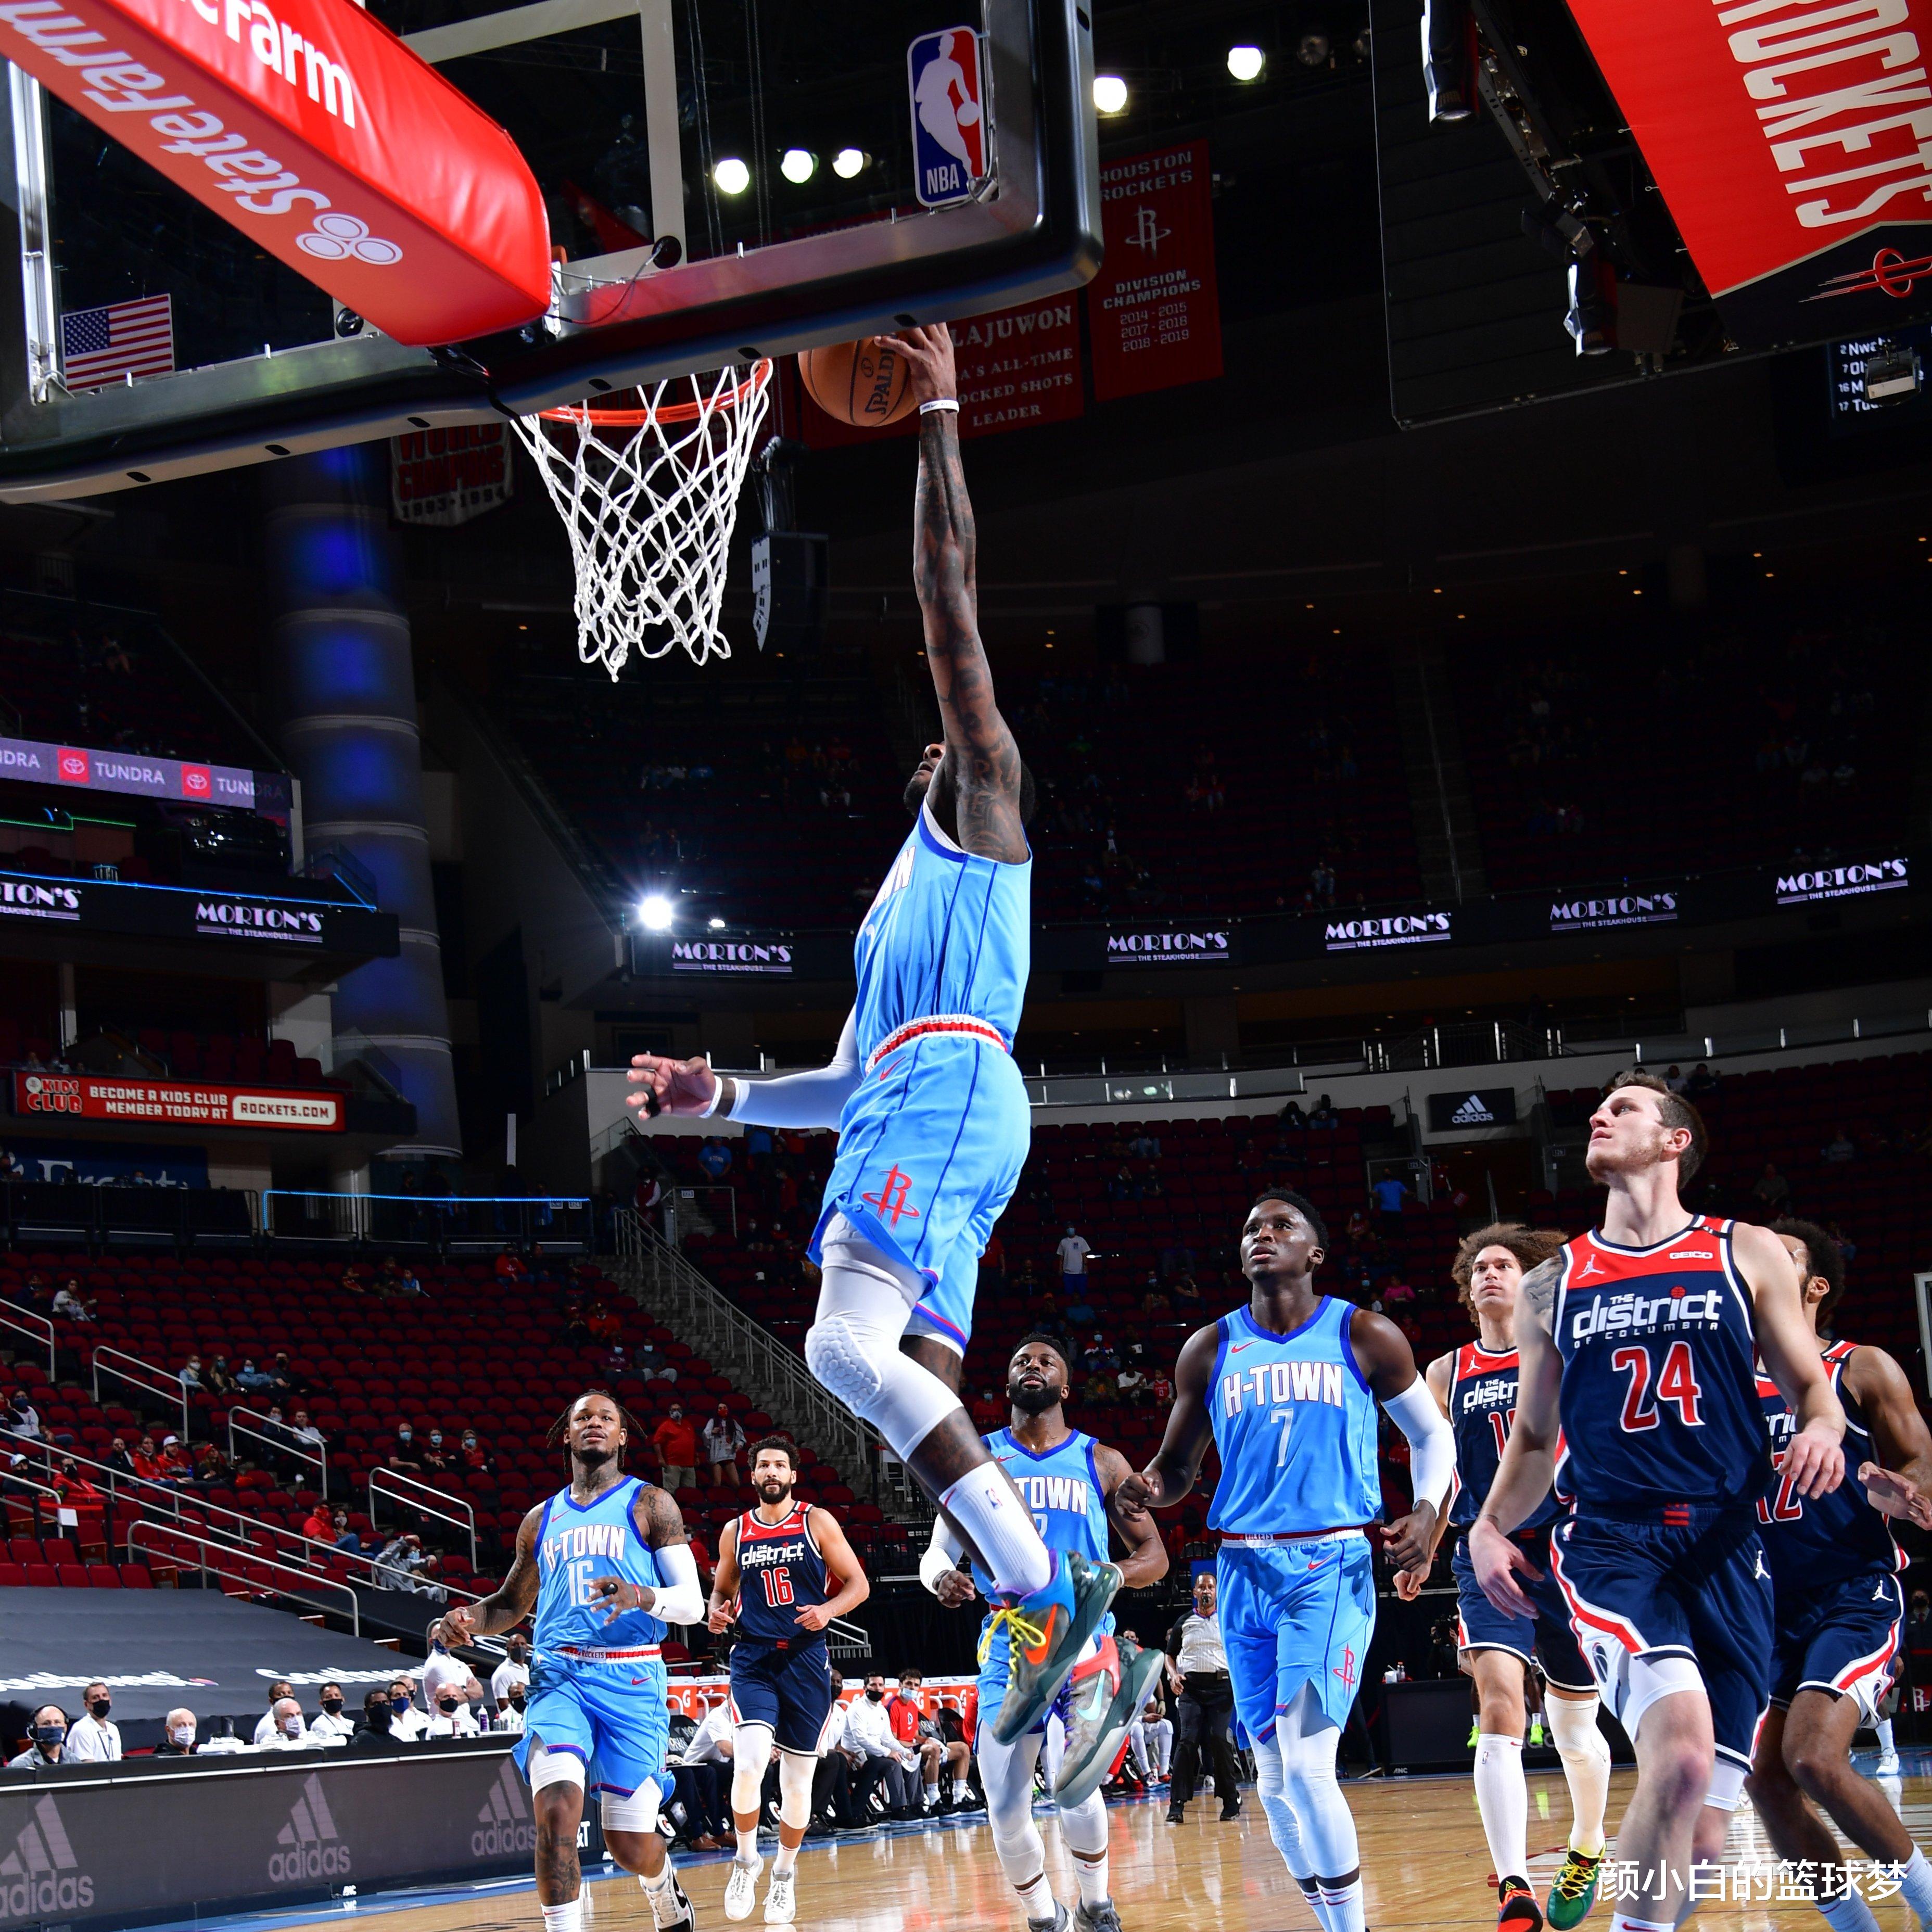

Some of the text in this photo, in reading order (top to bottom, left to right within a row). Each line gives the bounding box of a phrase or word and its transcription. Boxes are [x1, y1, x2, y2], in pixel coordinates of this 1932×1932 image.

[926, 163, 960, 195] NBA
[1100, 151, 1192, 183] HOUSTON
[1100, 170, 1193, 201] ROCKETS
[1103, 279, 1201, 309] CHAMPIONS
[1115, 269, 1187, 294] DIVISION
[949, 306, 1071, 348] LAJUWON
[1120, 310, 1149, 325] 2014
[1159, 302, 1187, 317] 2015
[1121, 324, 1149, 338] 2017
[1159, 315, 1187, 331] 2018
[1123, 337, 1151, 352] 2018
[1161, 329, 1189, 344] 2019
[865, 345, 896, 414] SPALDI
[957, 348, 1073, 382] A'S ALL-TIME
[958, 373, 1073, 405] OCKED SHOTS
[973, 404, 1041, 427] LEADER
[399, 446, 503, 501] CHAMPIONS
[95, 762, 166, 784] TUNDRA
[1775, 858, 1907, 894] MORTON'S
[0, 882, 80, 909] TON'S
[1550, 892, 1676, 921] MORTON'S
[195, 902, 322, 932] MORTON'S
[1325, 912, 1450, 940] MORTON'S
[671, 942, 792, 962] MORTON'S
[1107, 932, 1228, 952] MORTON'S
[41, 1078, 80, 1094] KIDS
[89, 1086, 228, 1105] BECOME A KIDS CLUB
[27, 1092, 83, 1113] CLUB
[106, 1101, 228, 1120] MEMBER TODAY AT
[240, 1102, 330, 1119] ROCKETS.COM
[1452, 1113, 1494, 1124] adidas
[1669, 1251, 1713, 1260] GEICO
[1573, 1286, 1723, 1339] district
[1610, 1293, 1635, 1305] THE
[1574, 1321, 1718, 1349] OF COLUMBIA
[1223, 1361, 1342, 1419] H-TOWN
[1463, 1380, 1519, 1409] distr
[1484, 1379, 1499, 1387] THE
[1611, 1341, 1706, 1433] 24
[1482, 1400, 1512, 1409] COLU
[1270, 1408, 1294, 1468] 7
[1013, 1476, 1088, 1516] TOWN
[543, 1524, 626, 1573] H-TOWN
[741, 1542, 805, 1566] district
[567, 1560, 595, 1607] 16
[760, 1566, 795, 1607] 16
[471, 1819, 537, 1857] adidas
[268, 1844, 351, 1883] adidas
